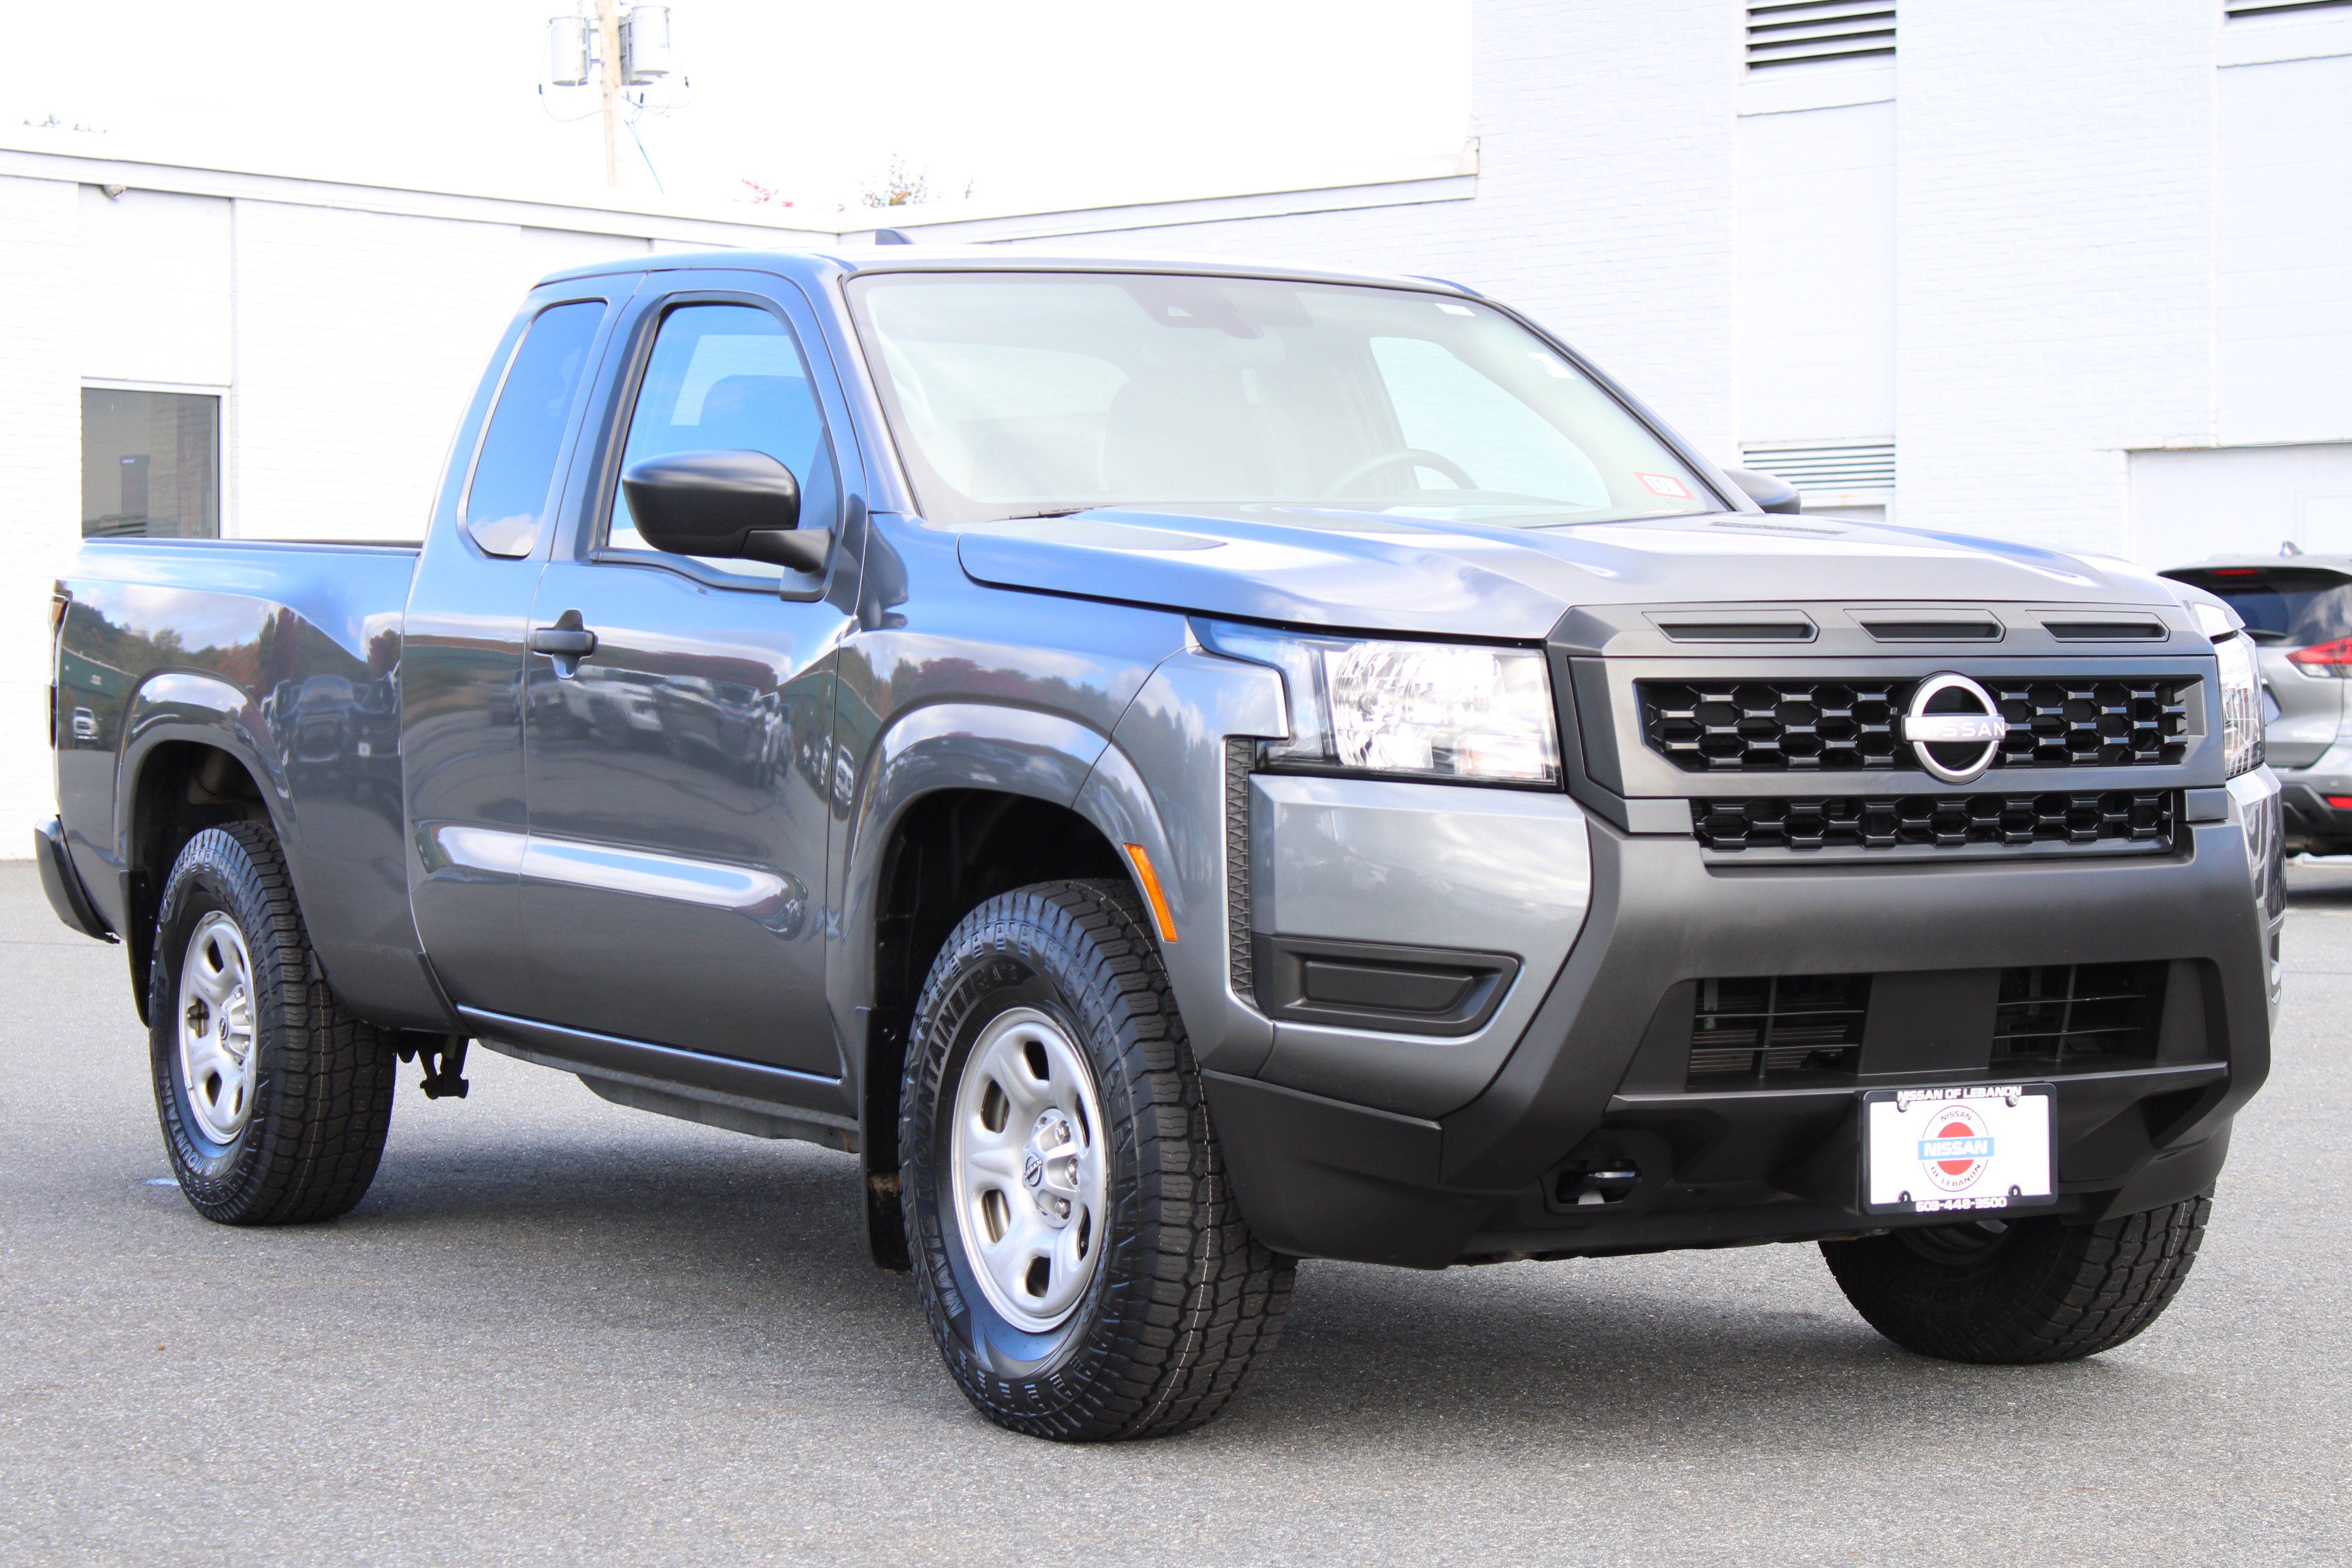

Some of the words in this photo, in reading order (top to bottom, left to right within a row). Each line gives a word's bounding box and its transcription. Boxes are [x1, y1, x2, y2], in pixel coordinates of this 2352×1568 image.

[1897, 1089, 1943, 1102] NISSAN
[1945, 1088, 1962, 1099] OF
[1963, 1086, 2022, 1099] LEBANON
[1941, 1110, 1972, 1122] NISSAN
[1924, 1139, 1988, 1157] NISSAN
[1942, 1164, 1981, 1187] LEBANON
[1915, 1196, 2007, 1213] 603-448-3500
[920, 1213, 965, 1321] MAVIS
